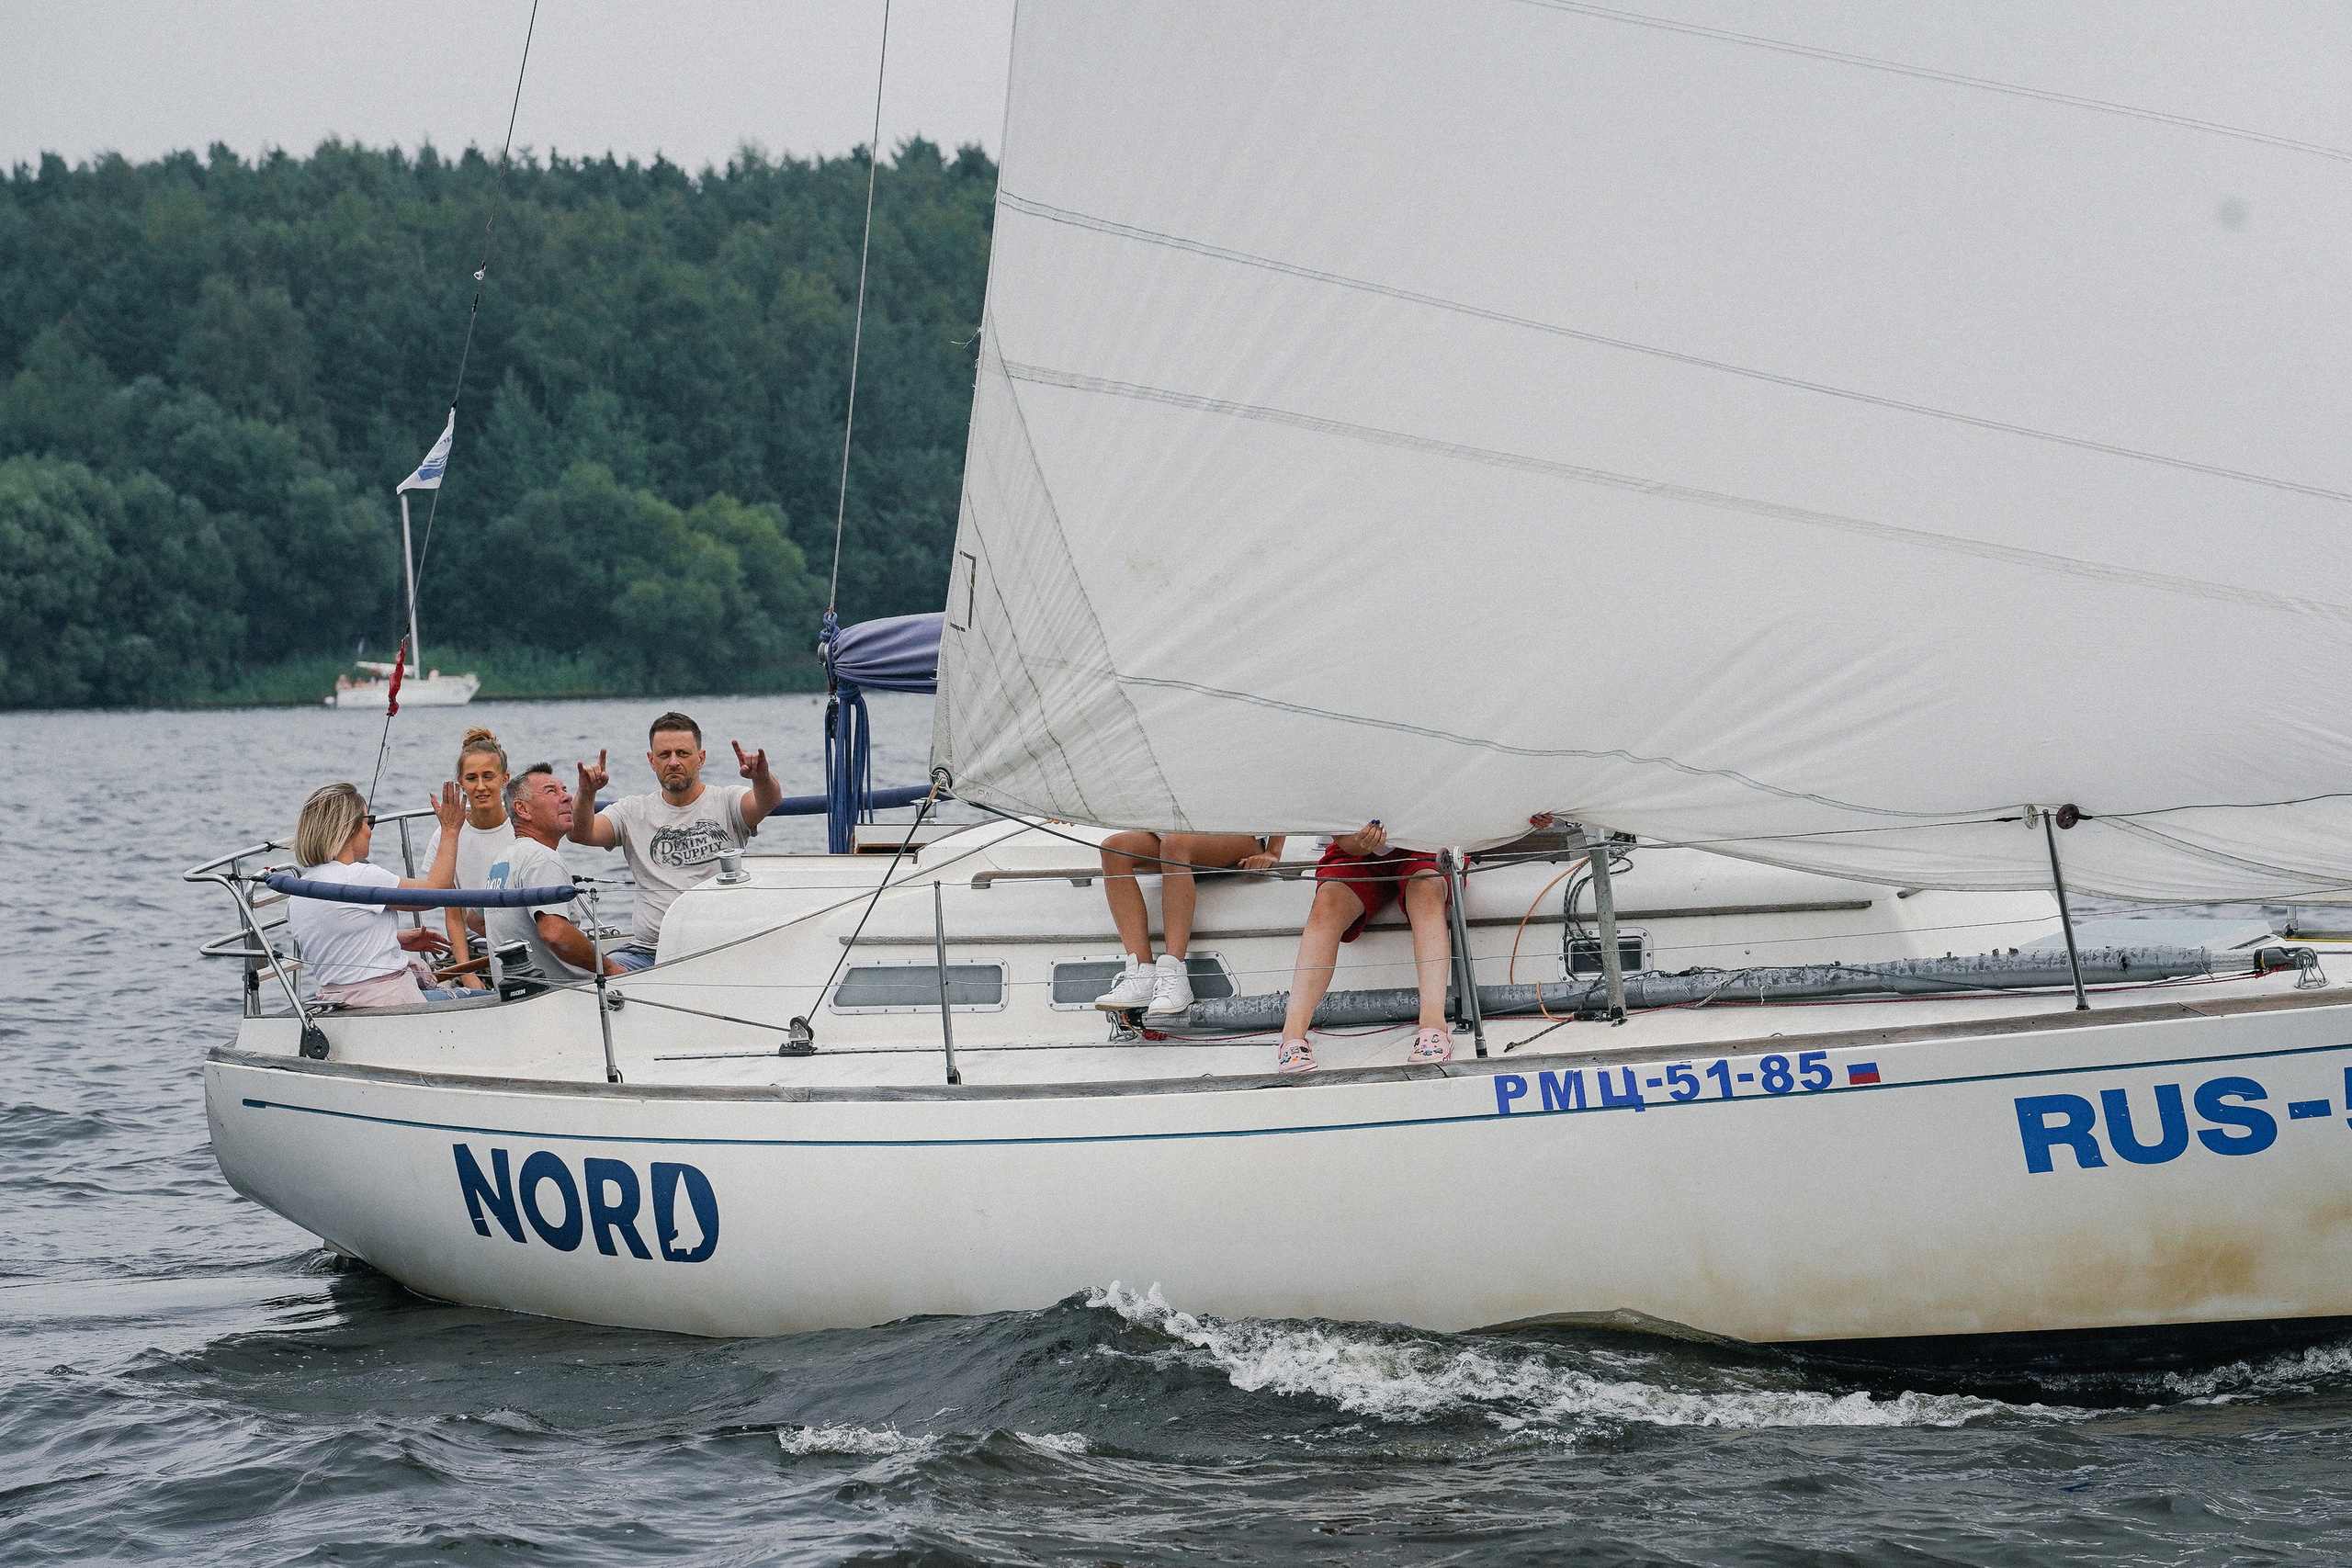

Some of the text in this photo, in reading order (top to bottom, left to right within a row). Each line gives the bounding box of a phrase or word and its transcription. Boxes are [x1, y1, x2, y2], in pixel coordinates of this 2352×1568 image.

[662, 837, 707, 855] DENIM
[662, 840, 722, 866] & SUPPLY
[2014, 1066, 2352, 1174] RUS-
[453, 1143, 719, 1263] NORD
